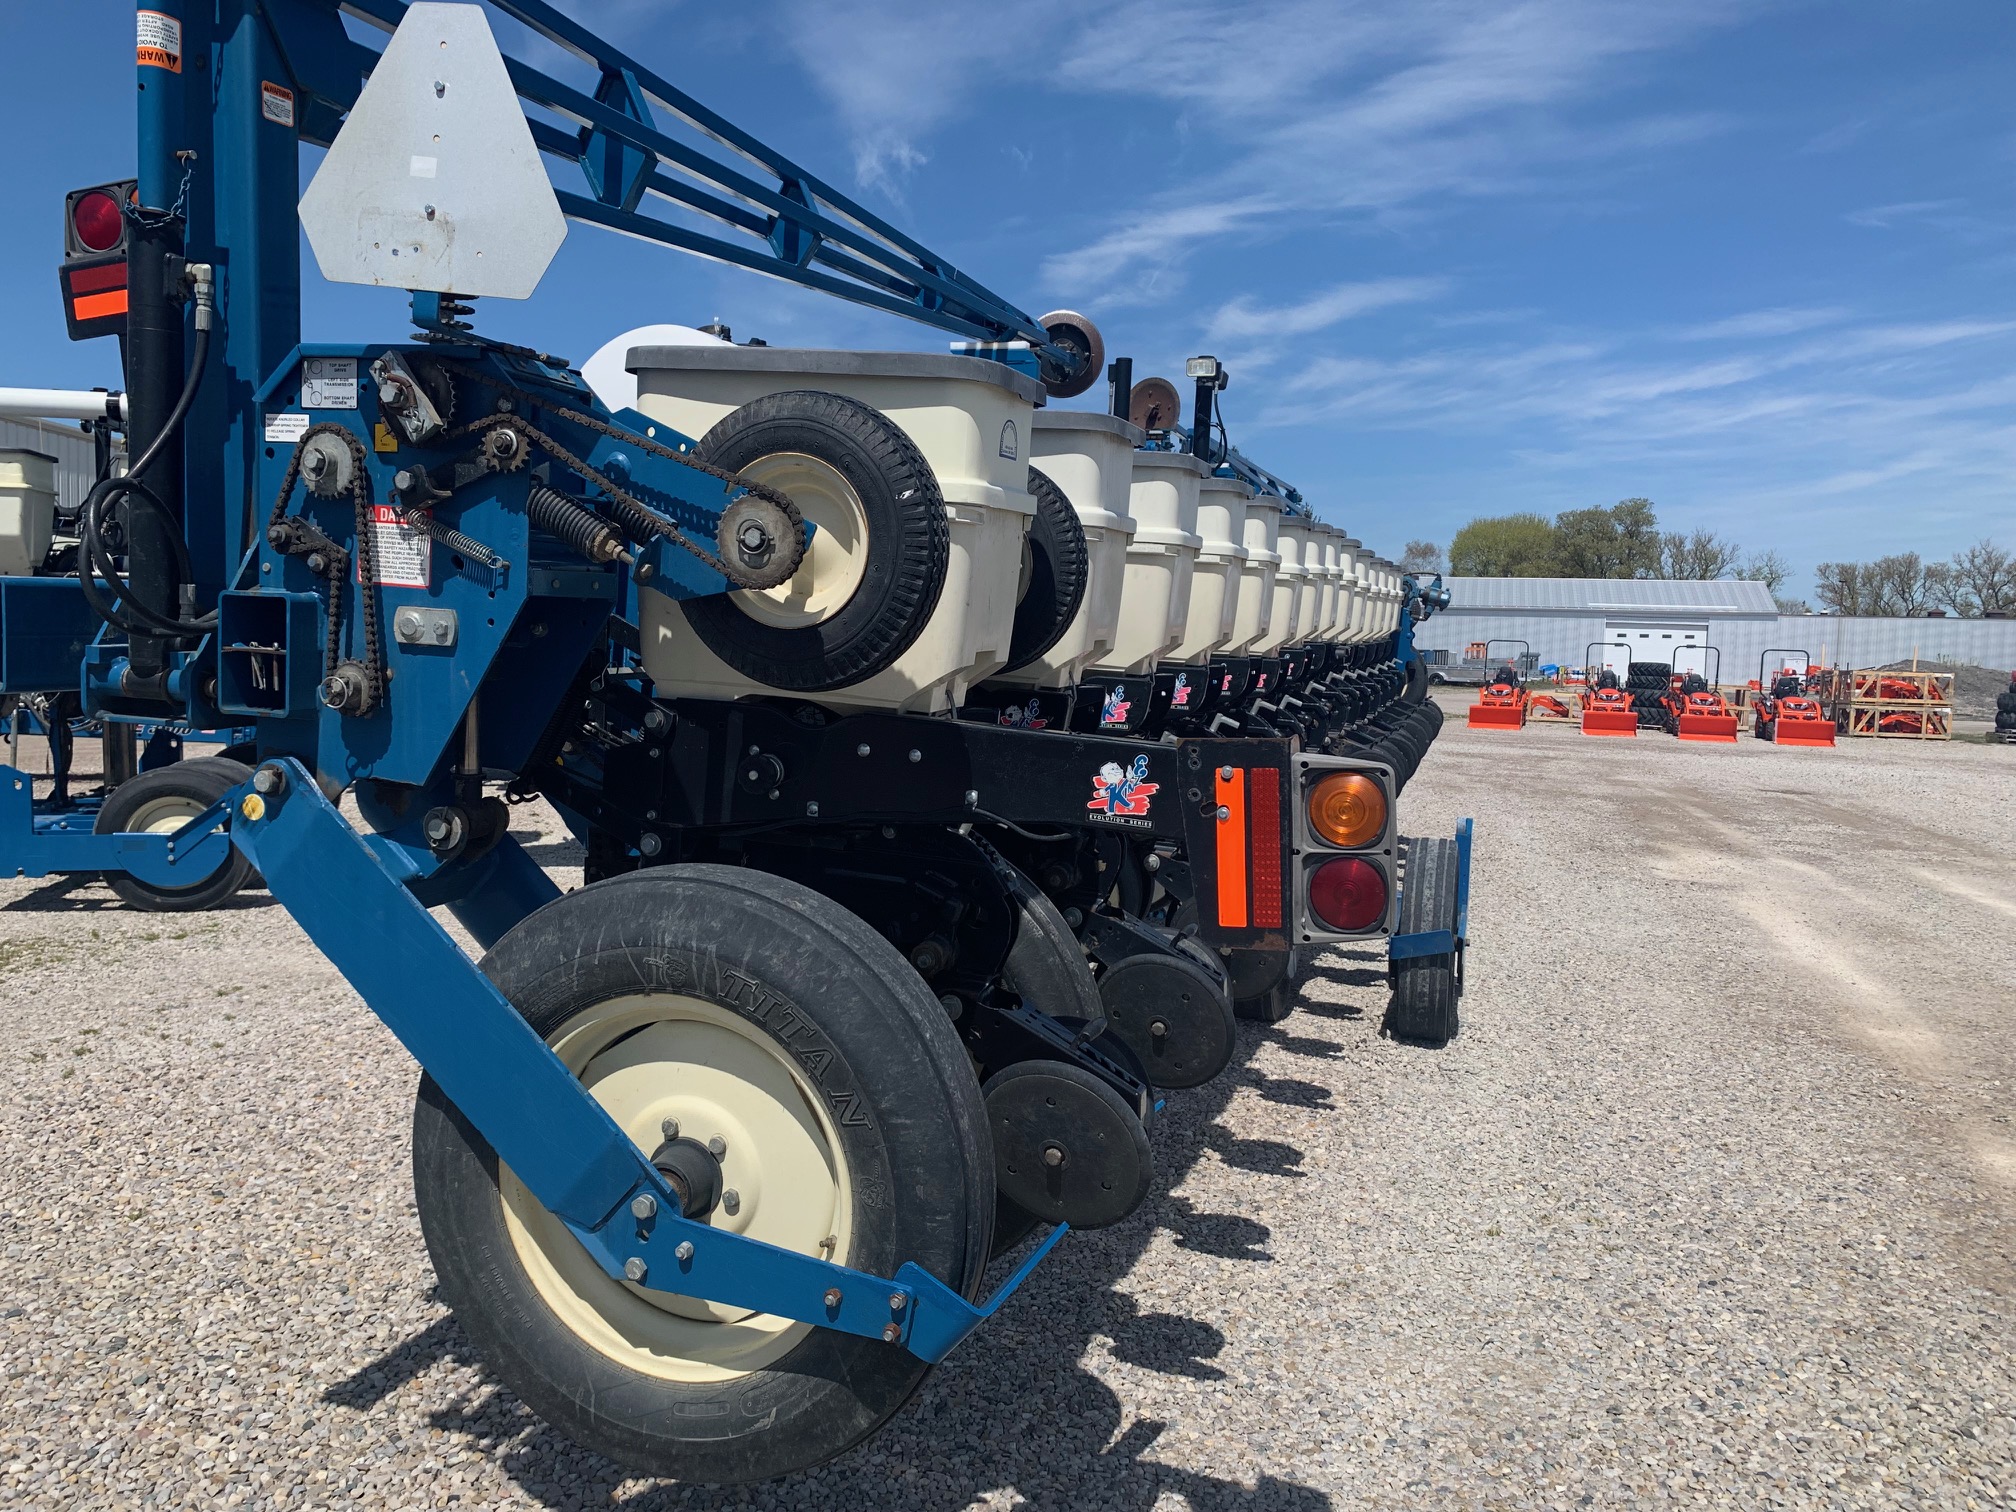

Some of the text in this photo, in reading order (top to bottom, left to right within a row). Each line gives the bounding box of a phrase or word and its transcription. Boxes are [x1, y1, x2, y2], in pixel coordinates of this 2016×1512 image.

[162, 36, 178, 46] ALWAYS
[163, 32, 178, 41] SAFETY
[1089, 814, 1152, 827] EVOLUTION SERIES
[716, 967, 873, 1130] TITAN
